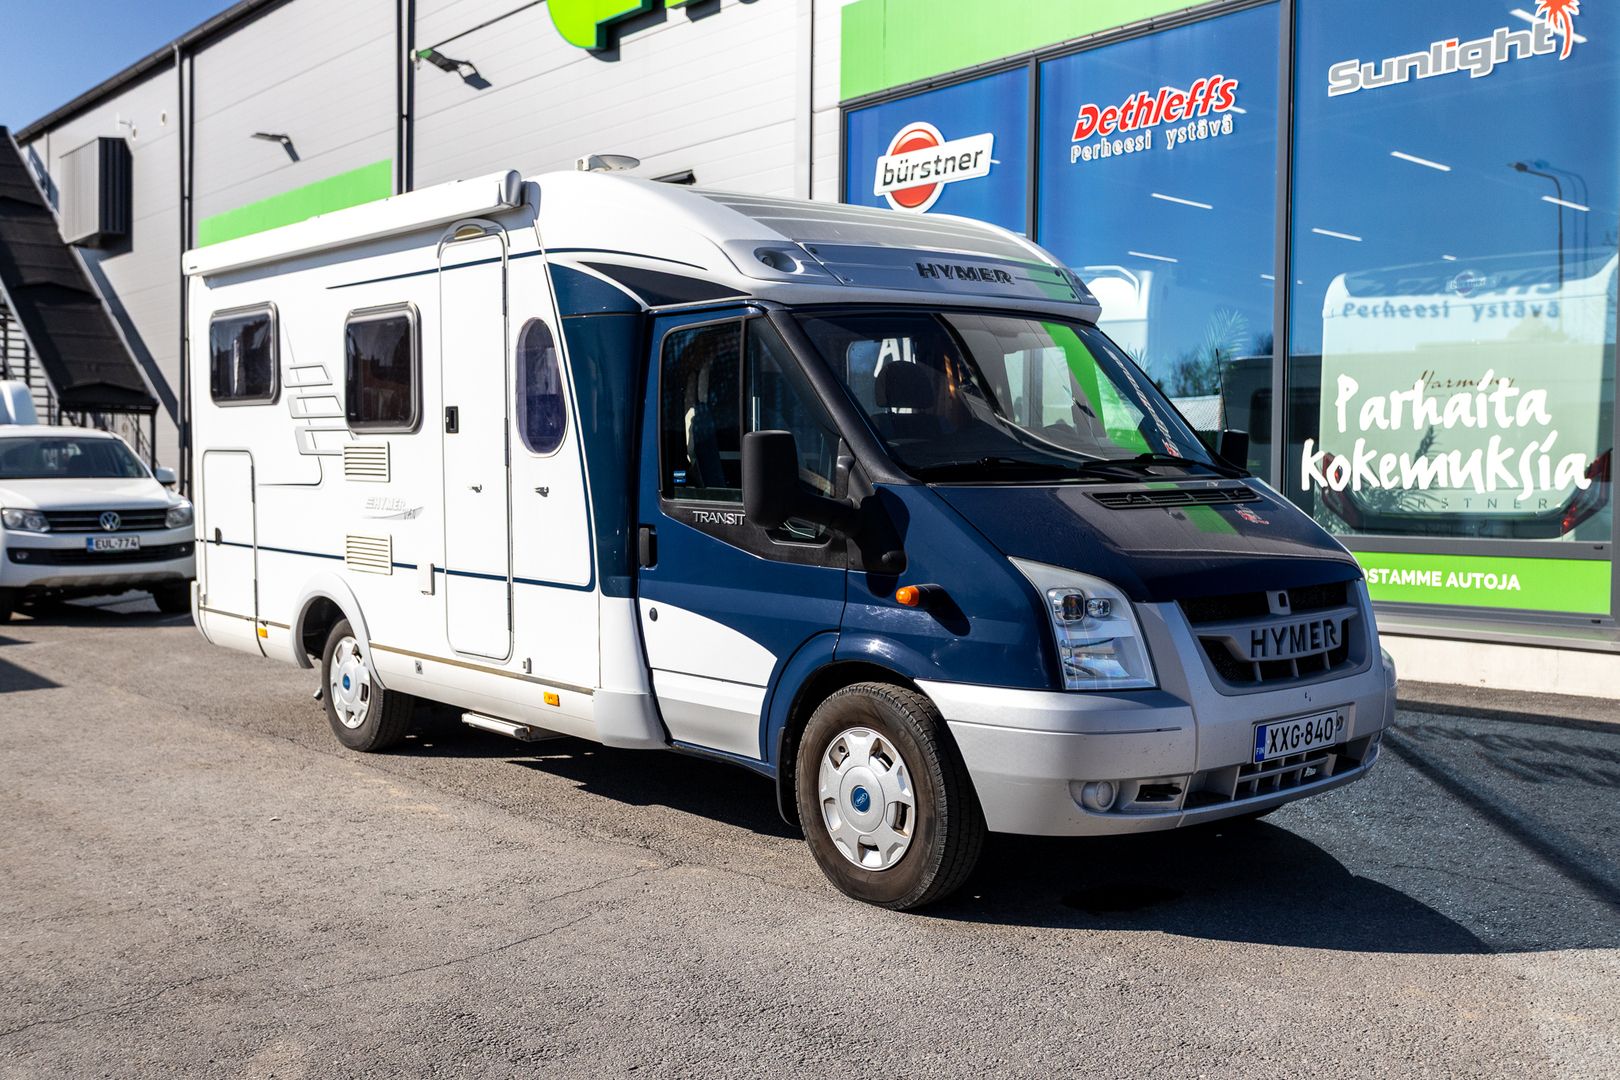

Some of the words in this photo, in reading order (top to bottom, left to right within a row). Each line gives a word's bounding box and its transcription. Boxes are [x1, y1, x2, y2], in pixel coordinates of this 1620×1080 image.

[1328, 21, 1556, 97] Sunlight
[1071, 75, 1238, 142] Dethleffs
[1071, 129, 1152, 163] Perheesi
[1166, 114, 1234, 150] ystävä
[882, 149, 984, 187] bürstner
[915, 262, 1015, 284] HYMER
[1335, 369, 1552, 432] Parhaita
[693, 511, 746, 525] TRANSIT
[95, 538, 137, 549] EUL-774
[1446, 572, 1521, 590] AUTOJA
[1251, 619, 1339, 659] HYMER
[1269, 717, 1333, 754] XXG-840
